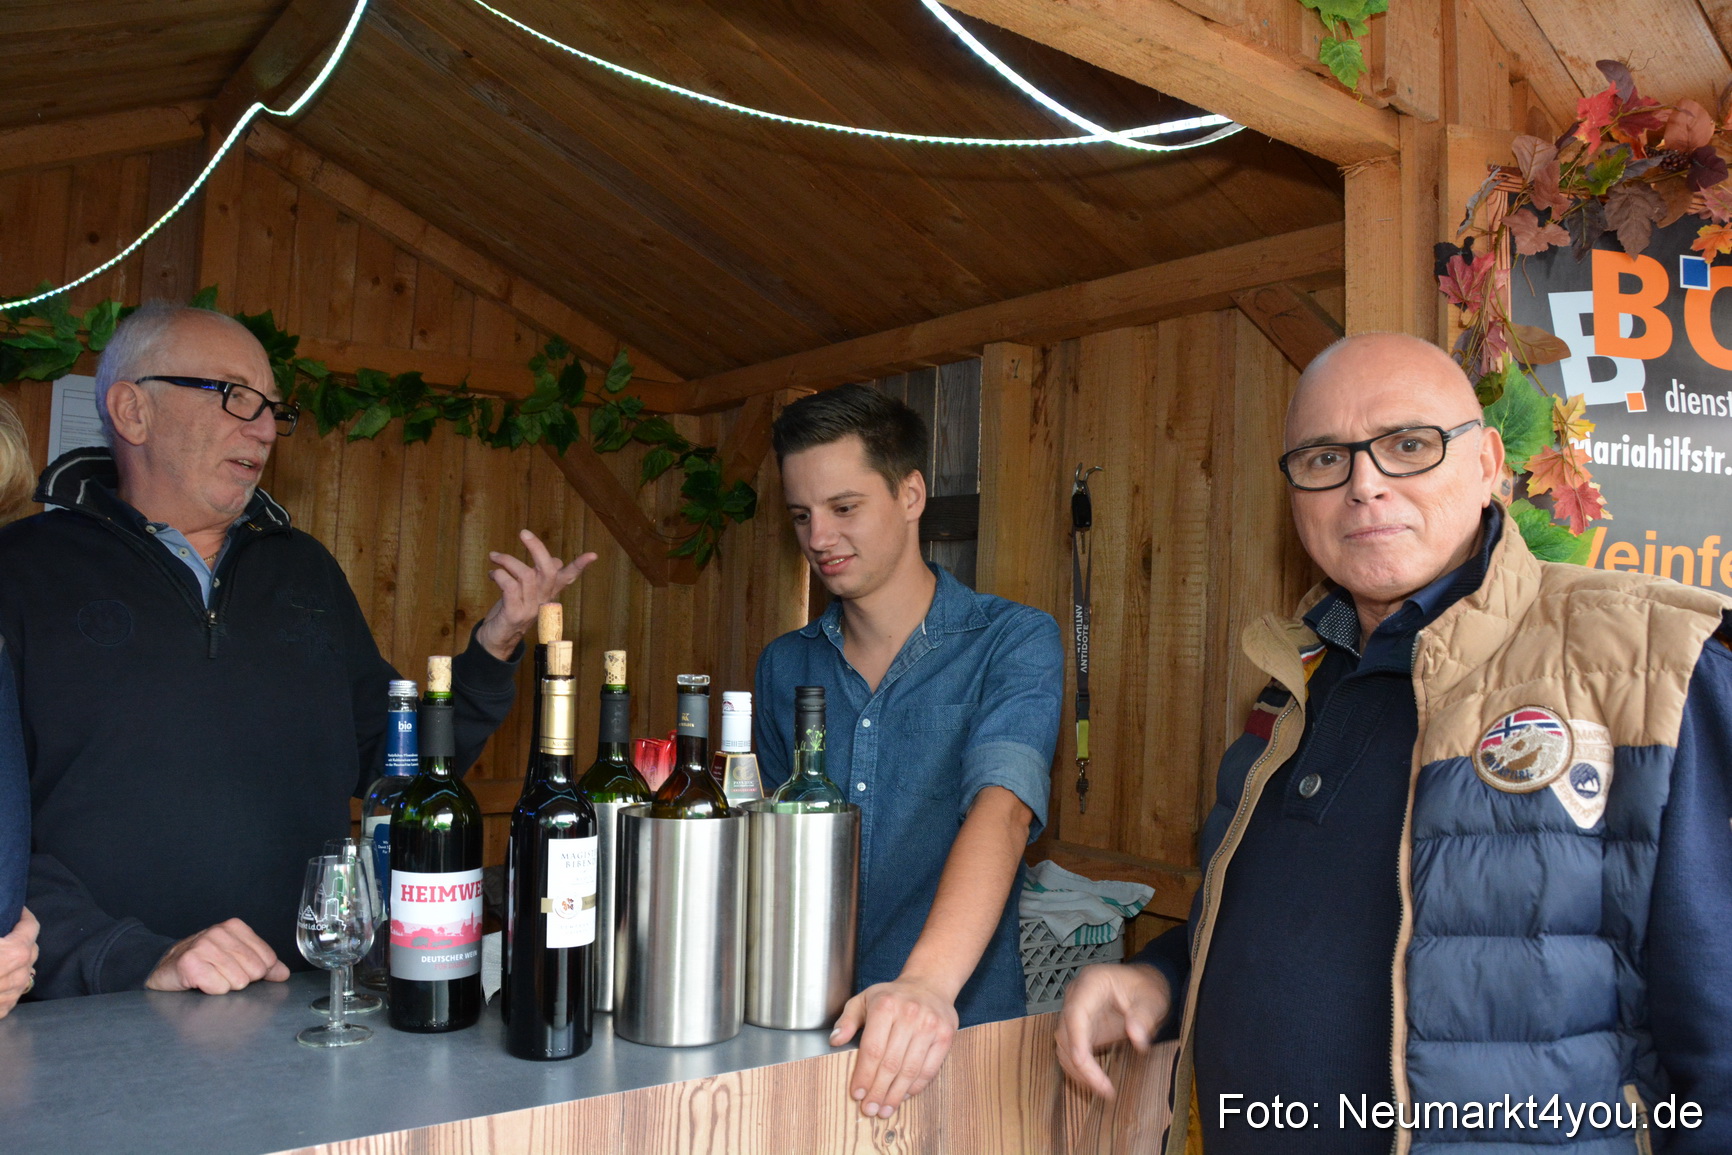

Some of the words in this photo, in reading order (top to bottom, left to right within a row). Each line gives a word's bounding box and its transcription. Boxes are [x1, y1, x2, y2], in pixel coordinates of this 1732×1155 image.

[1080, 624, 1089, 674] ANTIDOTE
[398, 721, 412, 730] bio
[421, 953, 463, 963] DEUTSCHER
[464, 949, 478, 959] WEIN
